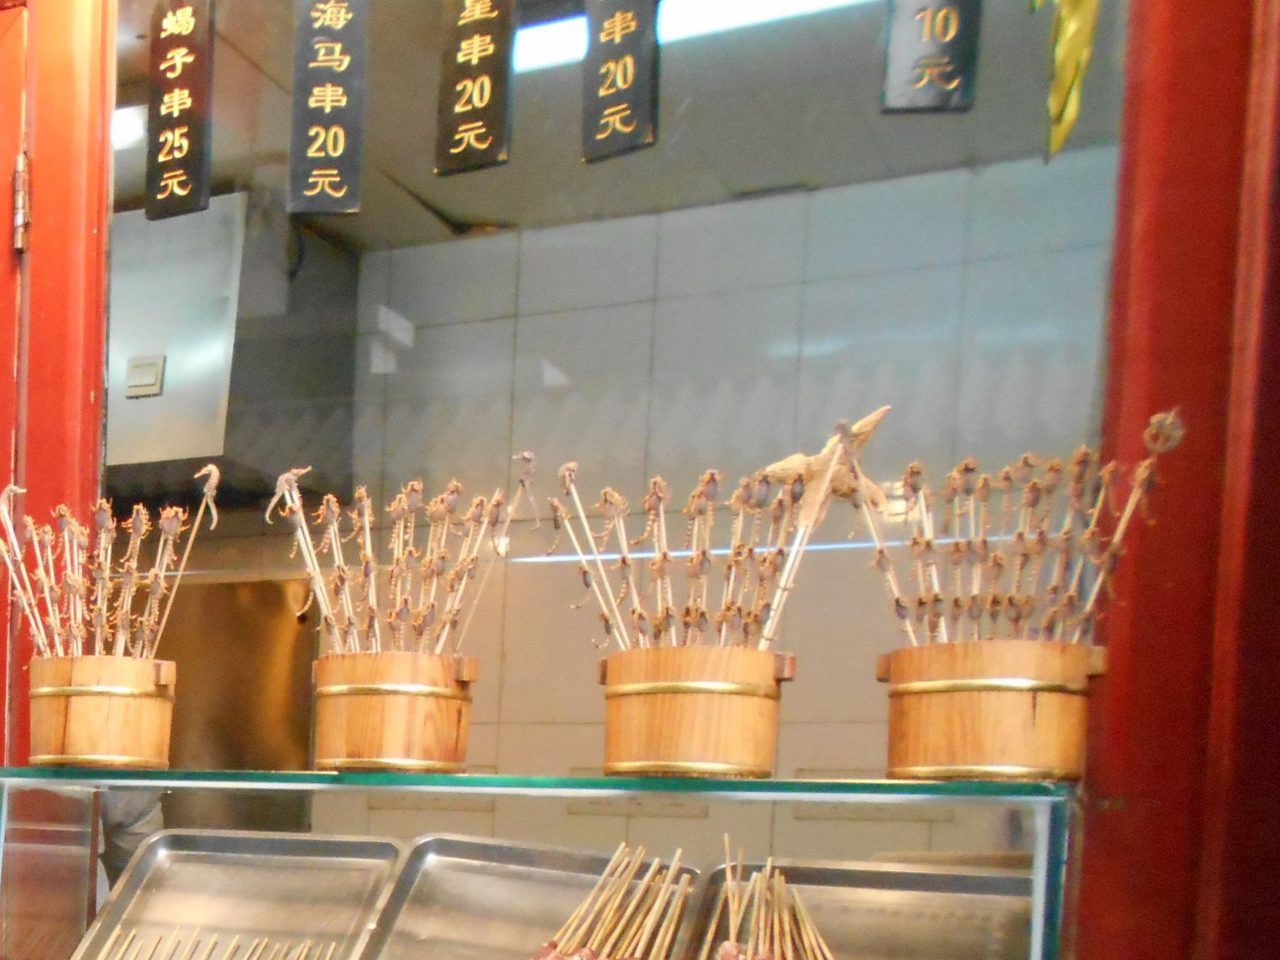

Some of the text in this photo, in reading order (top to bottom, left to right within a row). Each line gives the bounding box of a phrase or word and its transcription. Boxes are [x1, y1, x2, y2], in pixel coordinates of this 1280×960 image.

[157, 6, 195, 199] 蝎子串25元
[304, 0, 354, 198] 海马串20元
[912, 7, 961, 90] 10元
